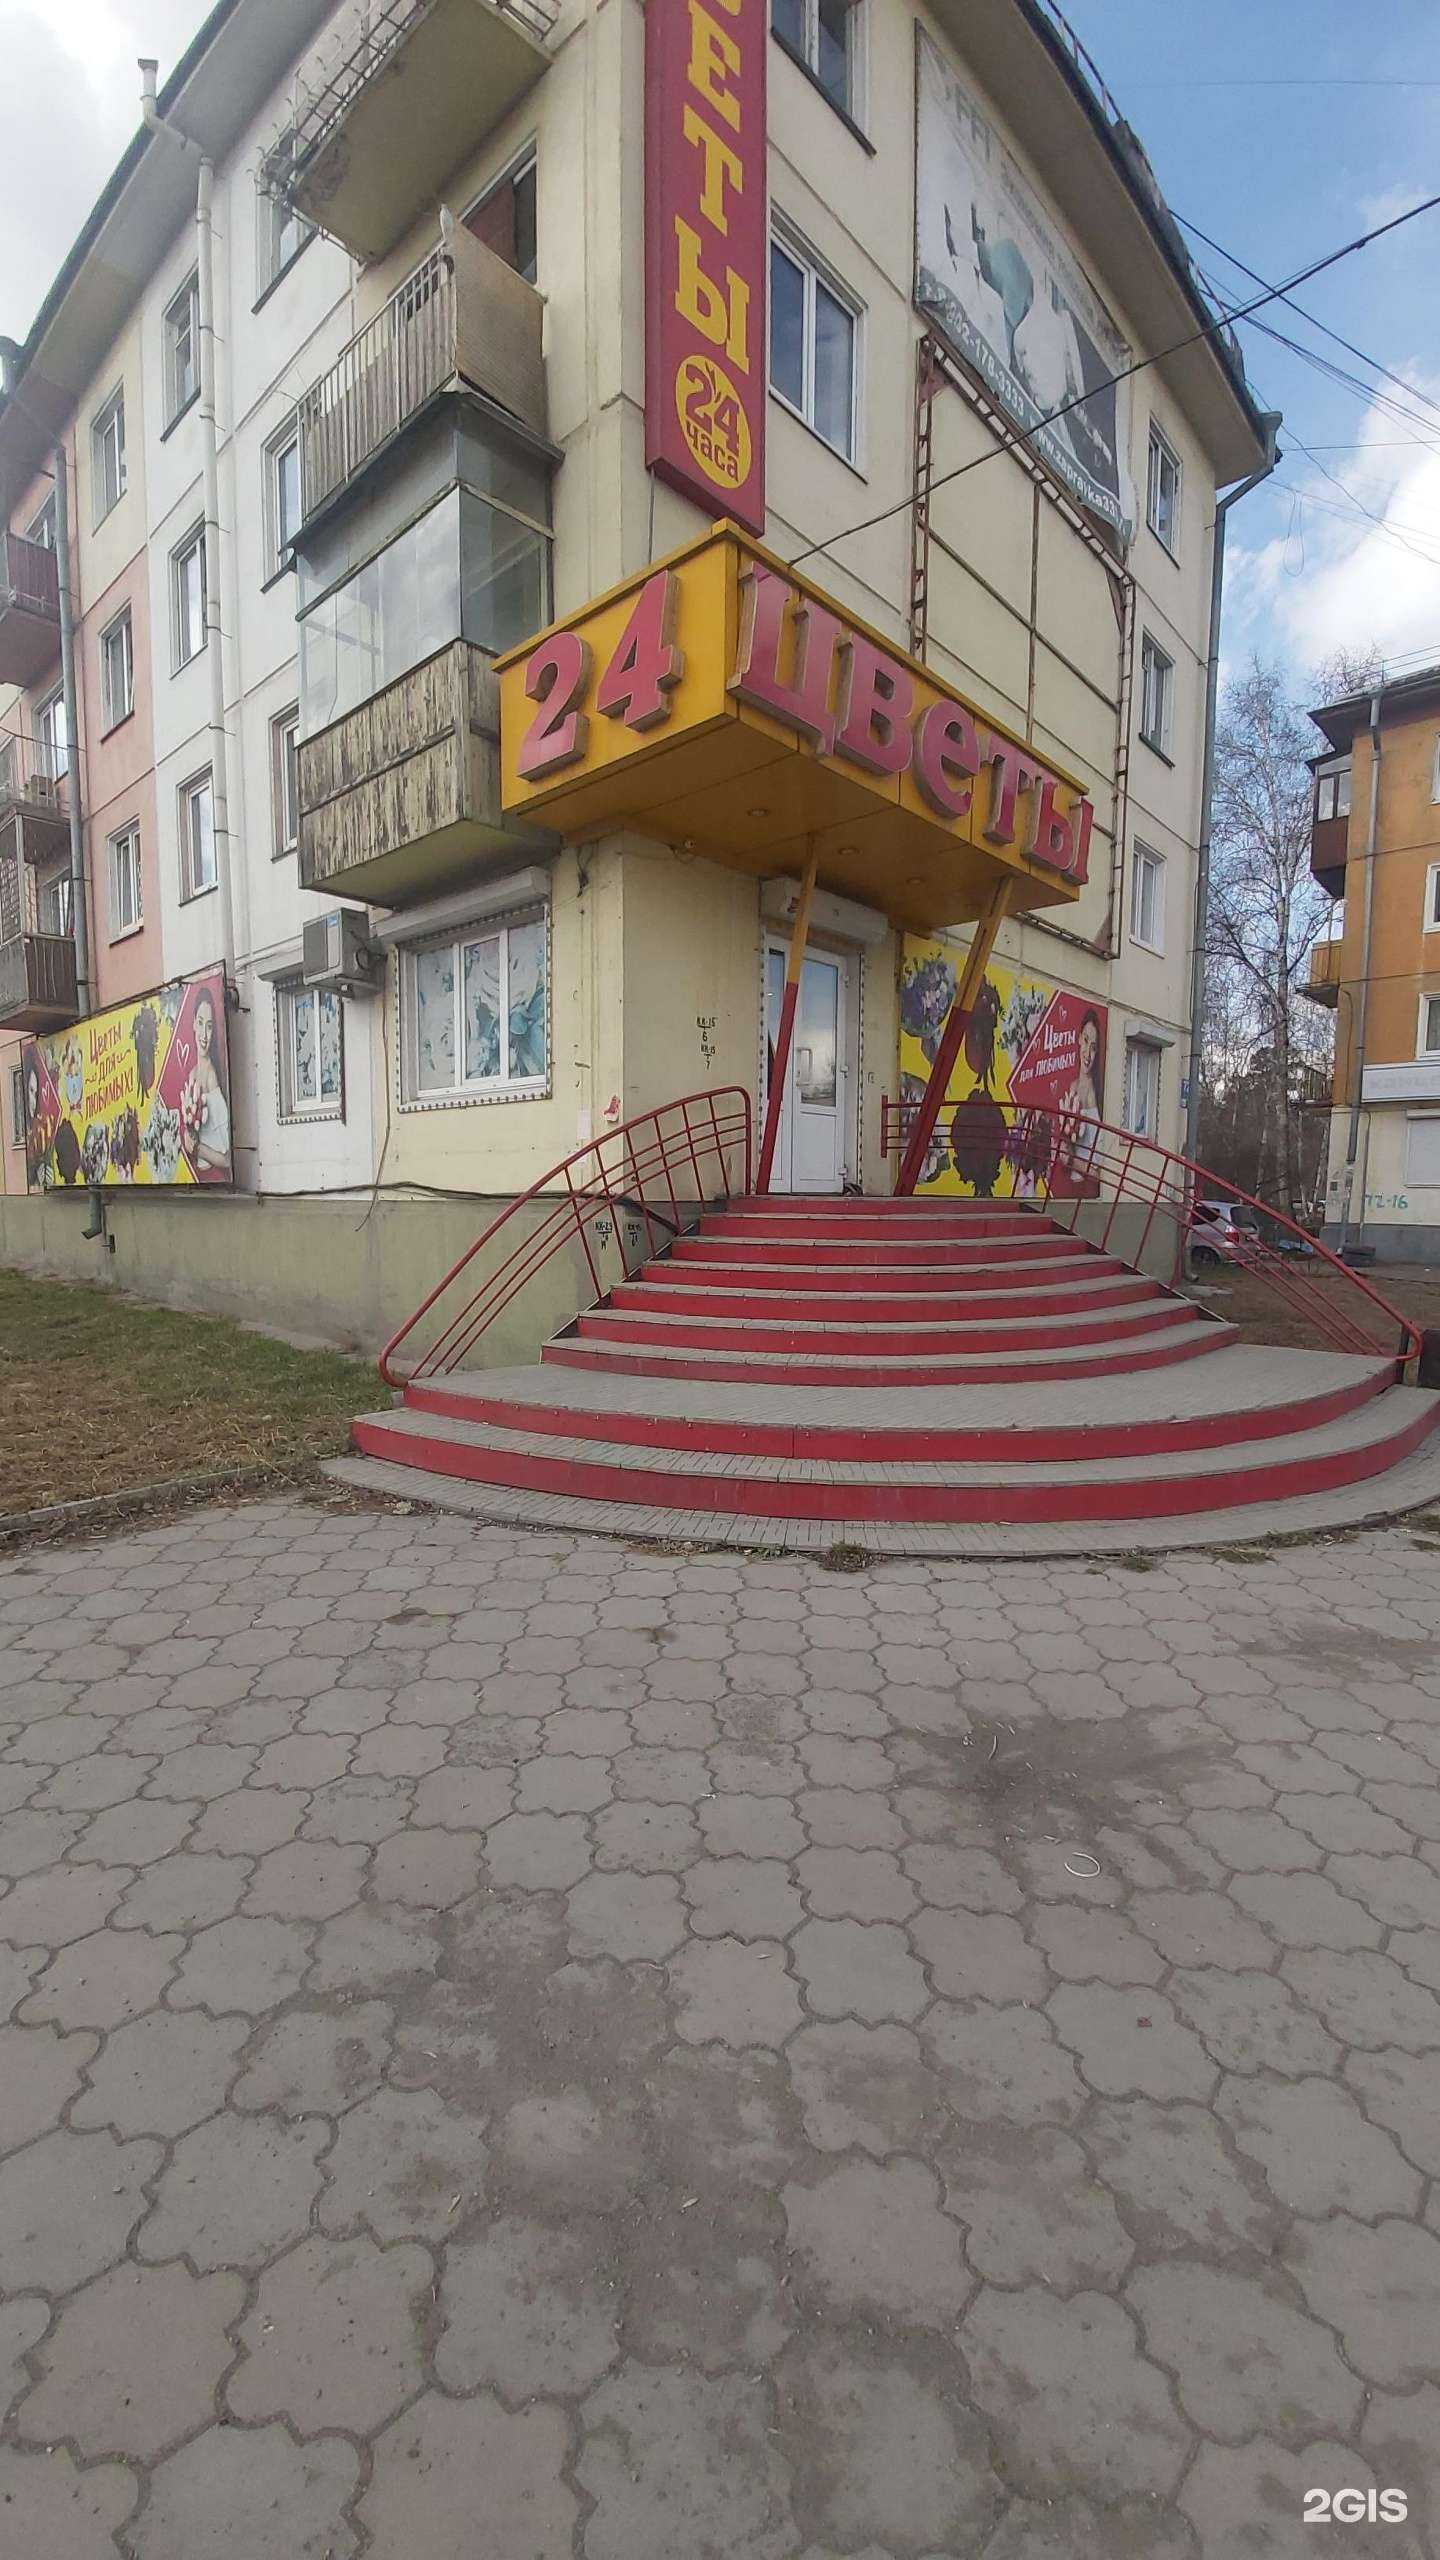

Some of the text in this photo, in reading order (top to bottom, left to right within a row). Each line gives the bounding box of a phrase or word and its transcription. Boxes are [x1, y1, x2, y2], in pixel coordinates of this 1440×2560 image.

[674, 0, 749, 375] ЕТЫ
[685, 363, 740, 457] 24
[685, 419, 740, 483] часа
[516, 569, 685, 781] 24
